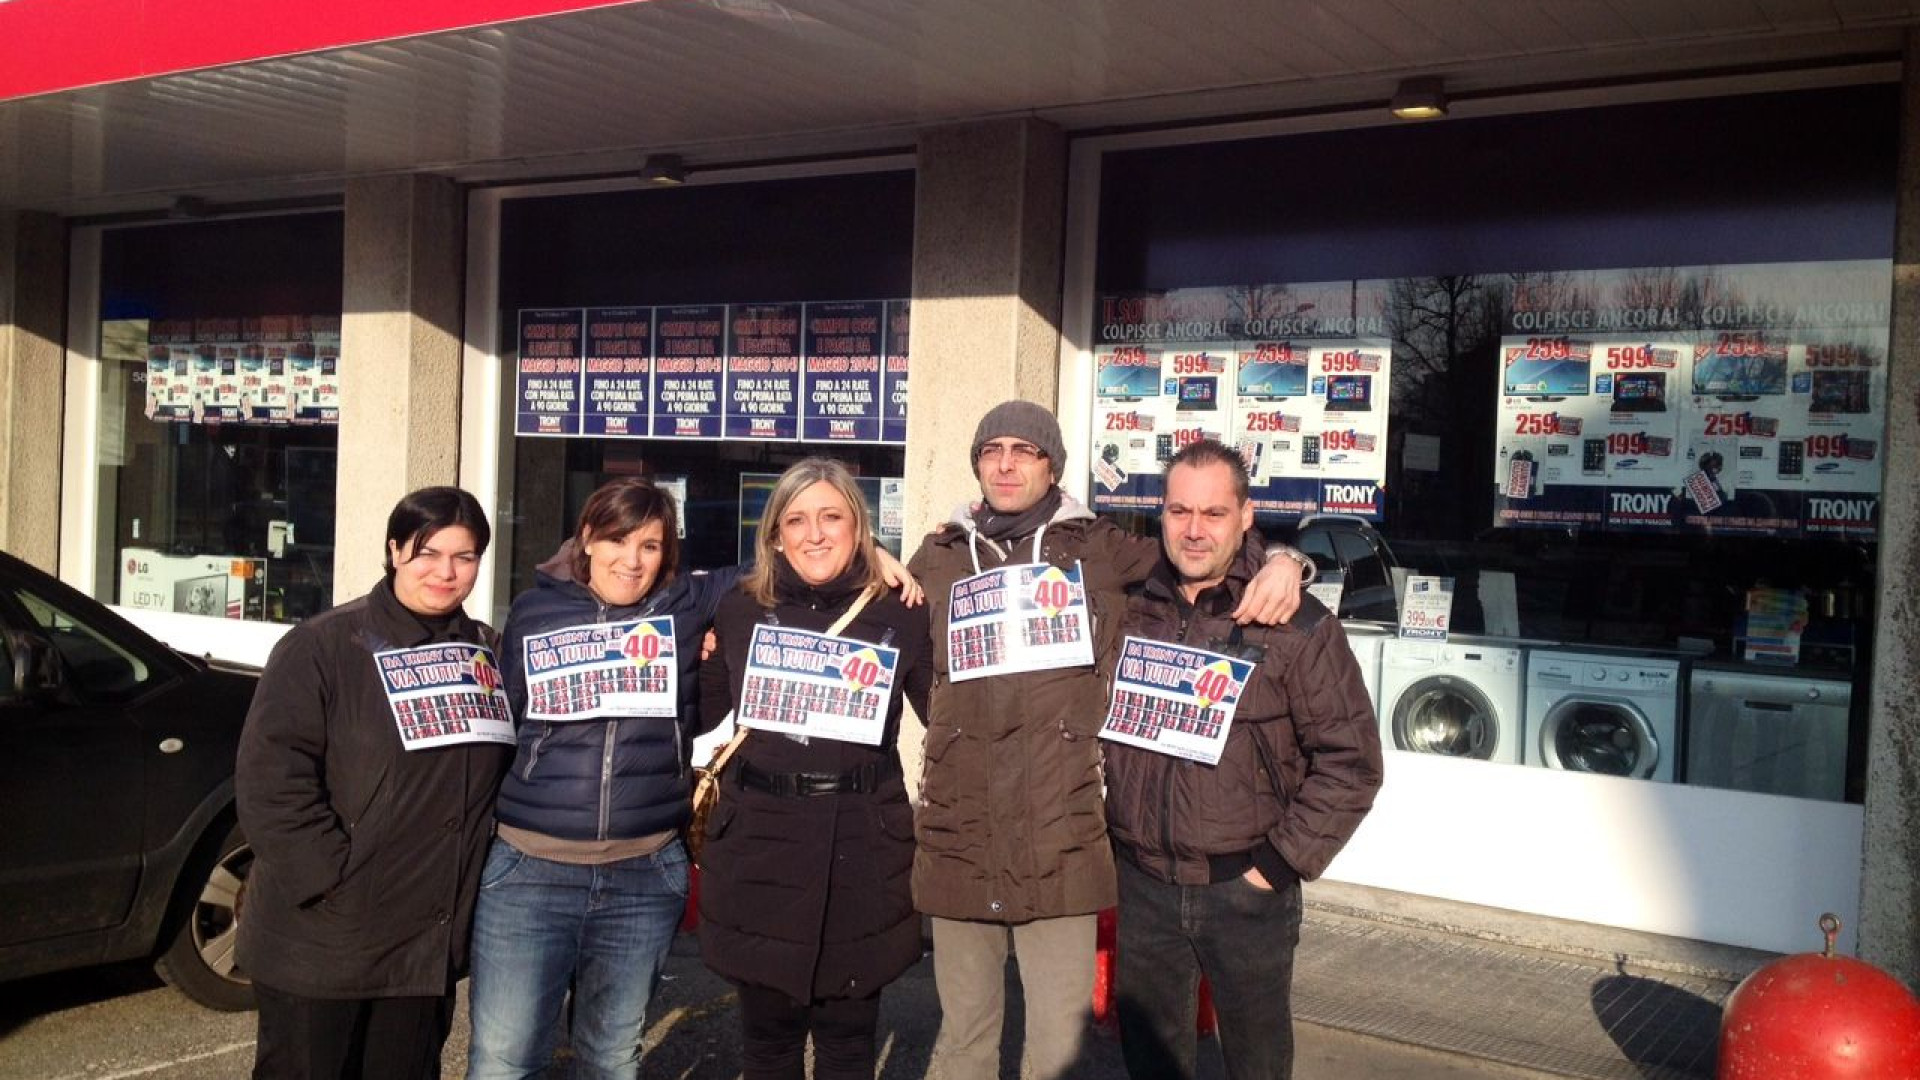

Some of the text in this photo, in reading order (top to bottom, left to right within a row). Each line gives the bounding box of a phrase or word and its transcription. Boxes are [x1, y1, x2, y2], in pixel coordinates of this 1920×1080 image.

[1244, 315, 1384, 338] COLPISCE ANCORA!
[1511, 307, 1680, 331] COLPISCE ANCORA!
[1103, 319, 1227, 341] COLPISCE ANCORA!
[521, 358, 555, 373] MAGGIO
[587, 358, 623, 373] MAGGIO
[657, 357, 694, 372] MAGGIO
[730, 357, 770, 372] MAGGIO
[806, 356, 849, 372] MAGGIO
[528, 379, 542, 390] FINO
[559, 379, 573, 390] RATE
[594, 379, 610, 390] FINO
[626, 379, 641, 390] RATE
[664, 379, 680, 390] FINO
[698, 379, 714, 390] RATE
[738, 379, 754, 390] FINO
[774, 379, 790, 390] RATE
[816, 379, 834, 391] FINO
[852, 379, 870, 391] RATE
[525, 390, 538, 401] CON
[560, 390, 575, 401] RATA
[591, 390, 605, 401] CON
[628, 390, 644, 401] RATA
[661, 390, 676, 402] CON
[700, 390, 716, 402] RATA
[733, 390, 751, 402] CON
[776, 390, 792, 402] RATA
[812, 391, 828, 402] CON
[854, 391, 872, 402] RATA
[539, 415, 561, 427] TRONY
[605, 416, 628, 428] TRONY
[676, 418, 700, 429] TRONY
[750, 418, 776, 430] TRONY
[829, 420, 856, 432] TRONY
[1324, 484, 1377, 504] TRONY
[1610, 492, 1672, 514] TRONY
[1808, 498, 1876, 520] TRONY
[137, 562, 149, 574] LG
[954, 573, 1003, 598] DA TRONY
[133, 591, 166, 607] LED TV
[953, 594, 975, 618] VIA
[530, 638, 549, 652] DA
[549, 630, 591, 647] TRONY
[758, 630, 777, 645] DA
[778, 632, 819, 650] TRONY
[383, 656, 403, 669] DA
[402, 648, 443, 665] TRONY
[530, 648, 559, 671] VIA
[558, 641, 605, 665] TUTTI!
[754, 644, 781, 666] VIA
[782, 646, 829, 673] TUTTI!
[1126, 642, 1143, 657] DA
[1142, 645, 1178, 664] TRONY
[387, 662, 463, 690] VIA TUTTI!
[1121, 656, 1183, 688] VIA TUTTI!
